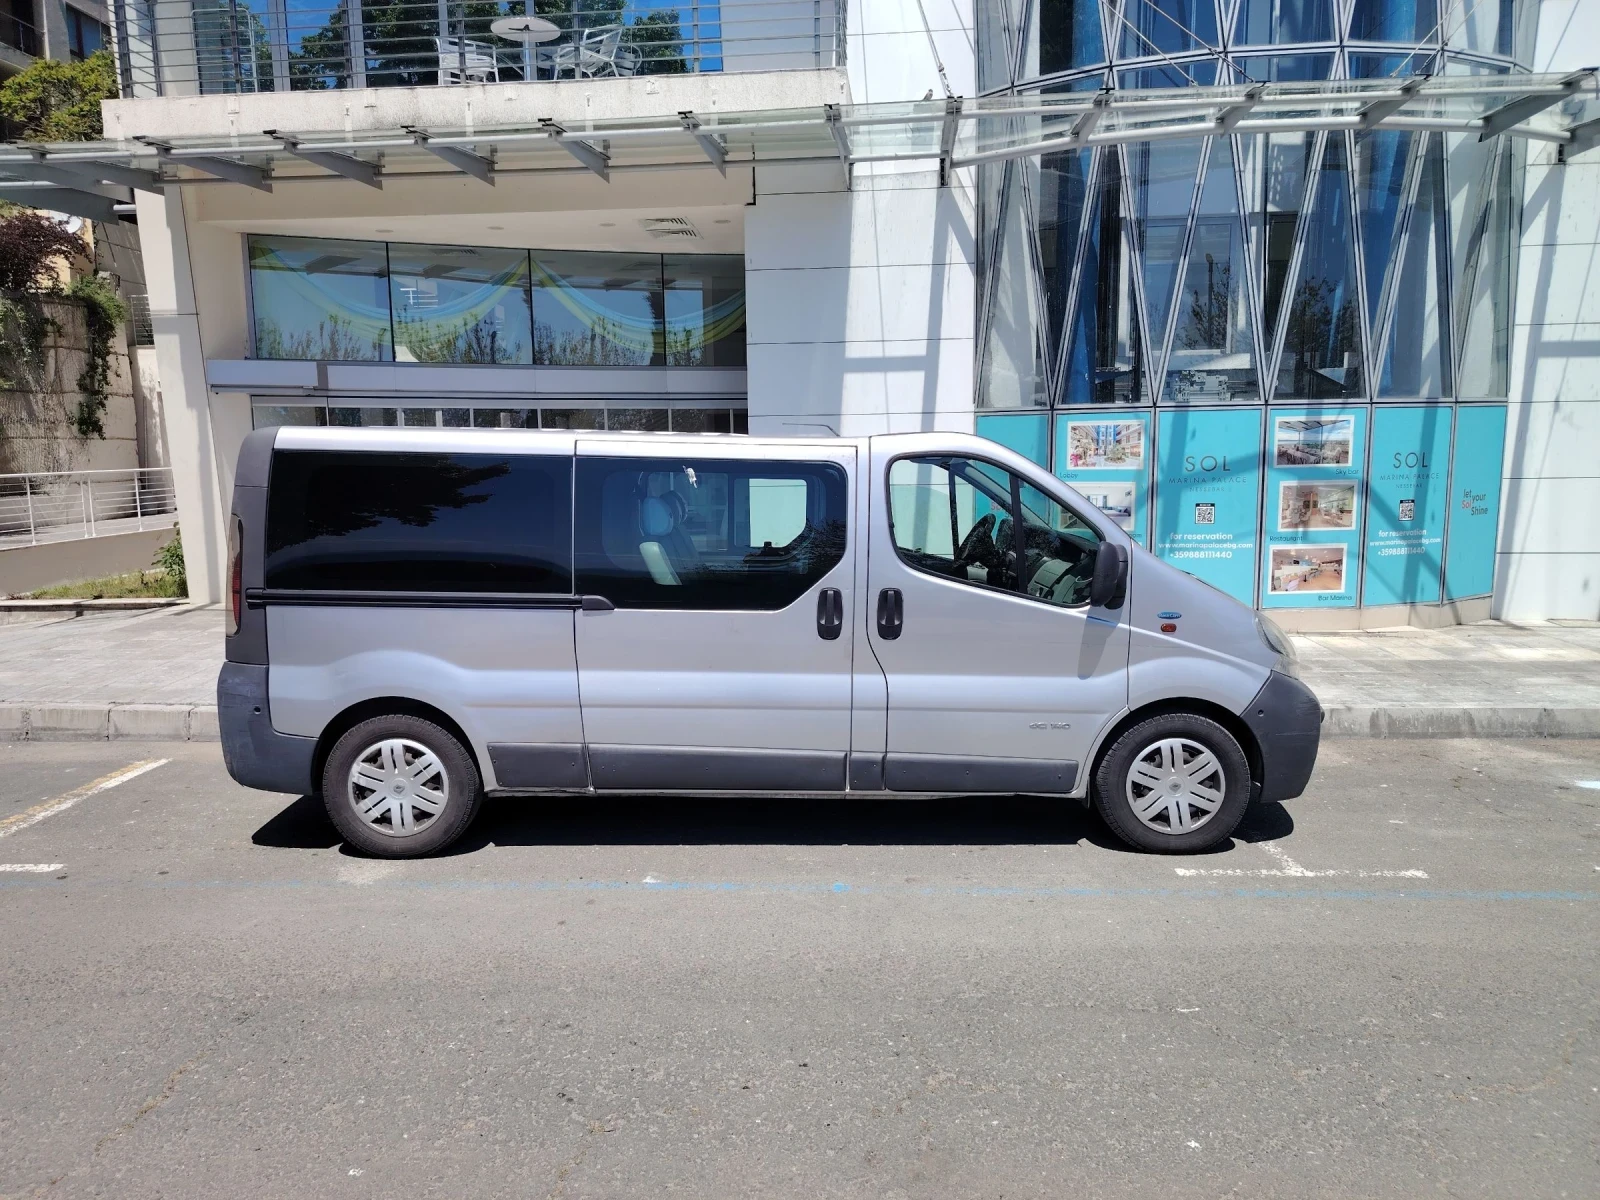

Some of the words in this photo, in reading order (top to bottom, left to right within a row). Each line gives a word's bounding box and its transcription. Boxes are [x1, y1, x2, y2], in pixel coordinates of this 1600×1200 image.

[1185, 456, 1231, 472] SOL
[1393, 452, 1428, 469] SOL
[1413, 472, 1440, 480] PALACE
[1463, 489, 1472, 499] let
[1472, 494, 1487, 503] your
[1461, 500, 1471, 509] Sol
[1470, 506, 1489, 516] Shine
[1170, 532, 1182, 540] for
[1183, 532, 1233, 540] reservation
[1389, 528, 1427, 537] reservation
[1170, 551, 1232, 559] +359888111440
[1378, 547, 1426, 556] +359888111440
